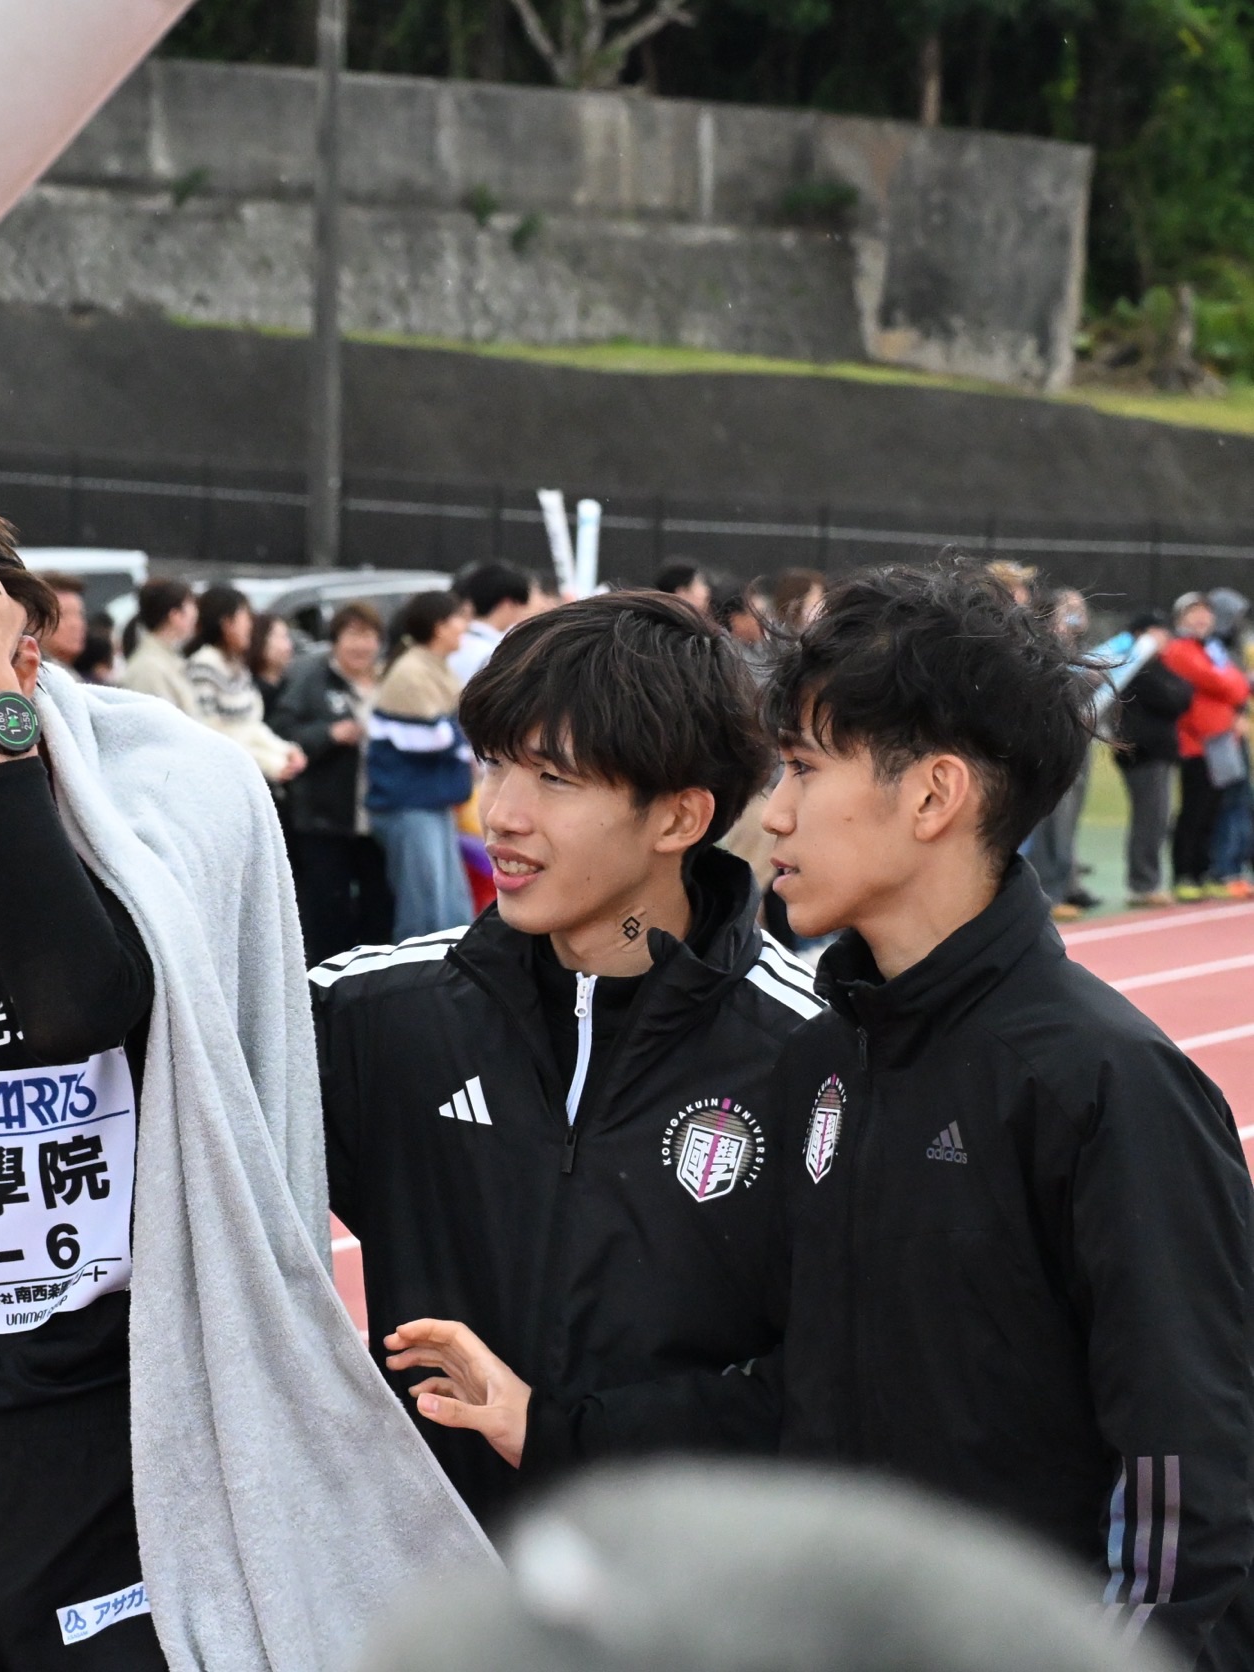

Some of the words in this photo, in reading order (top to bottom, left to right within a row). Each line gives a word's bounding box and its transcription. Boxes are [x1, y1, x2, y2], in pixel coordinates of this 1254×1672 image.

[661, 1097, 720, 1167] KOKUGAKUIN
[733, 1103, 766, 1189] UNIVERSITY
[926, 1144, 968, 1164] adidas
[93, 1586, 149, 1625] アサガ
